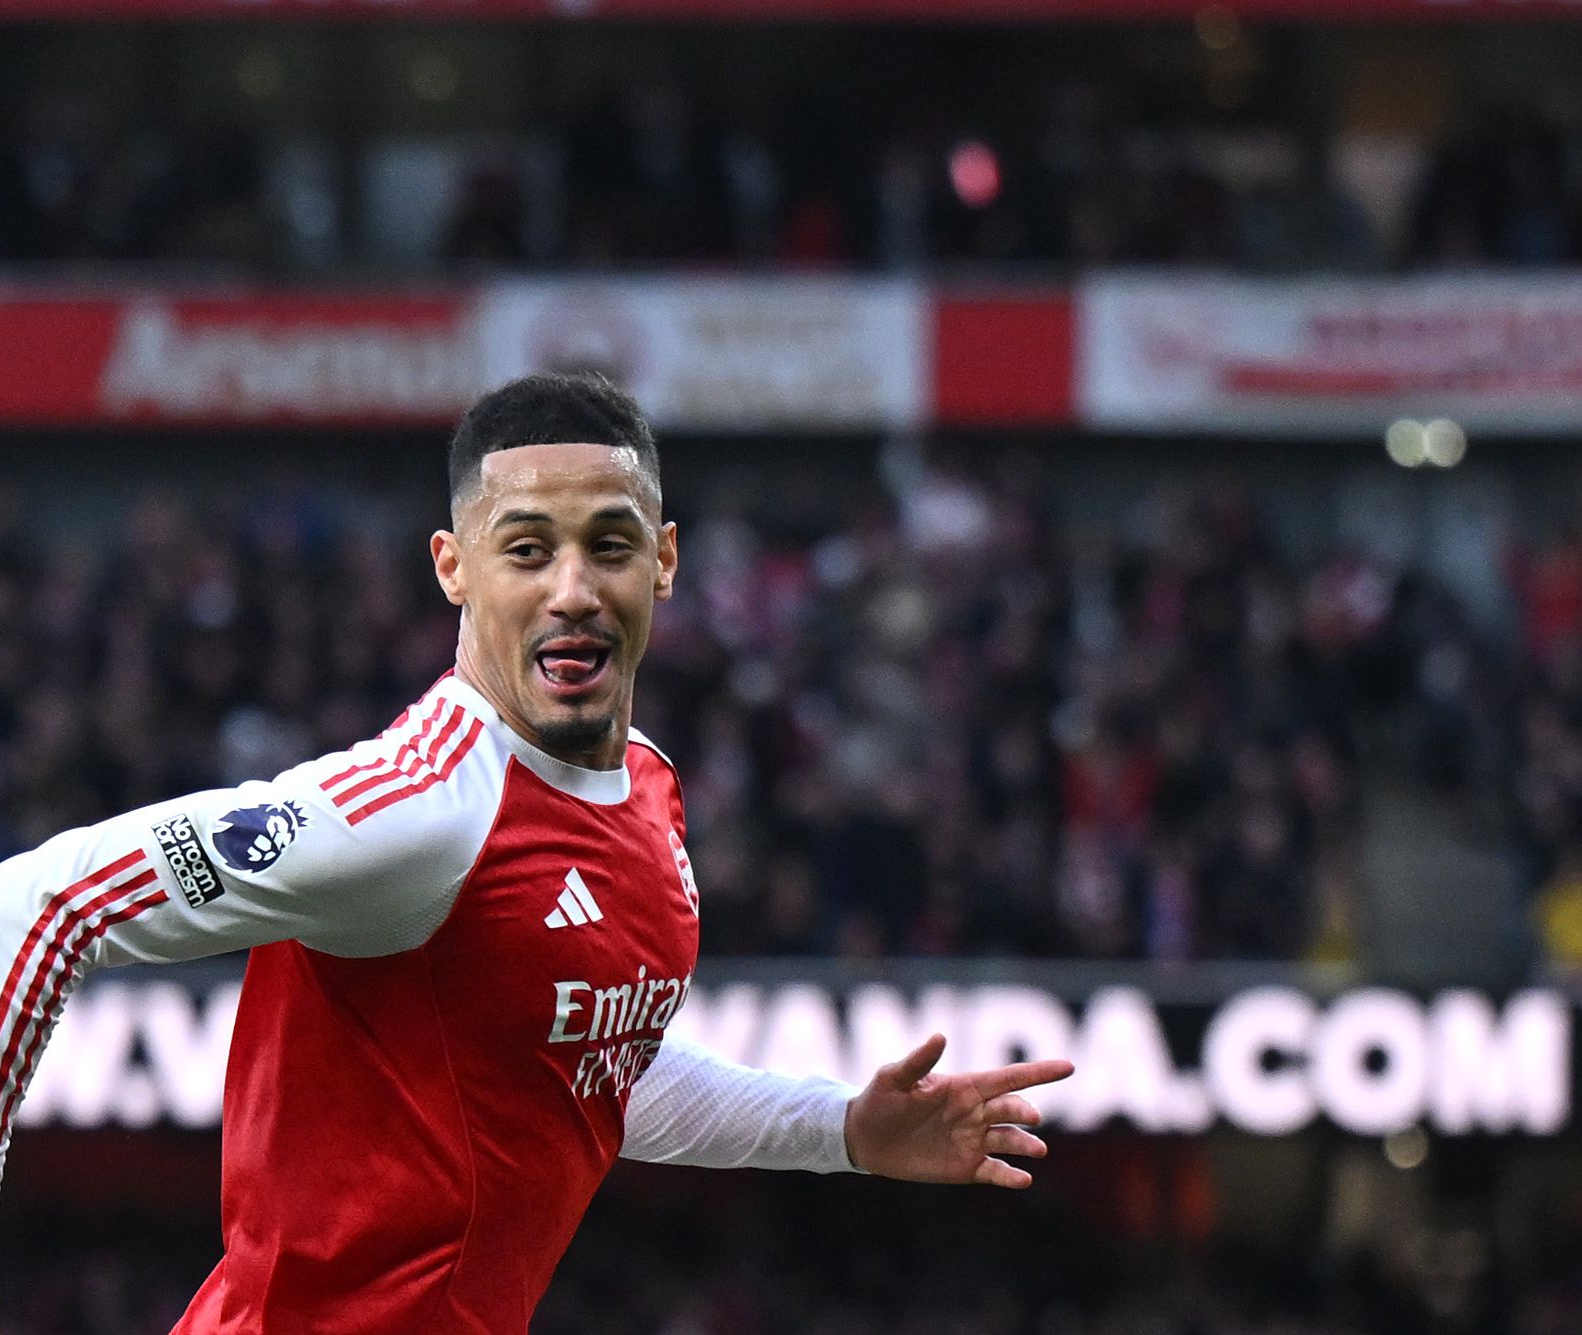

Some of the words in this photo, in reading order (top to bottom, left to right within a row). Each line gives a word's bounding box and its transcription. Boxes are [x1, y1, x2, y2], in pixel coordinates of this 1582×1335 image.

[173, 814, 191, 841] No
[166, 846, 205, 908] racism
[181, 839, 216, 893] room
[548, 965, 692, 1043] Emirat
